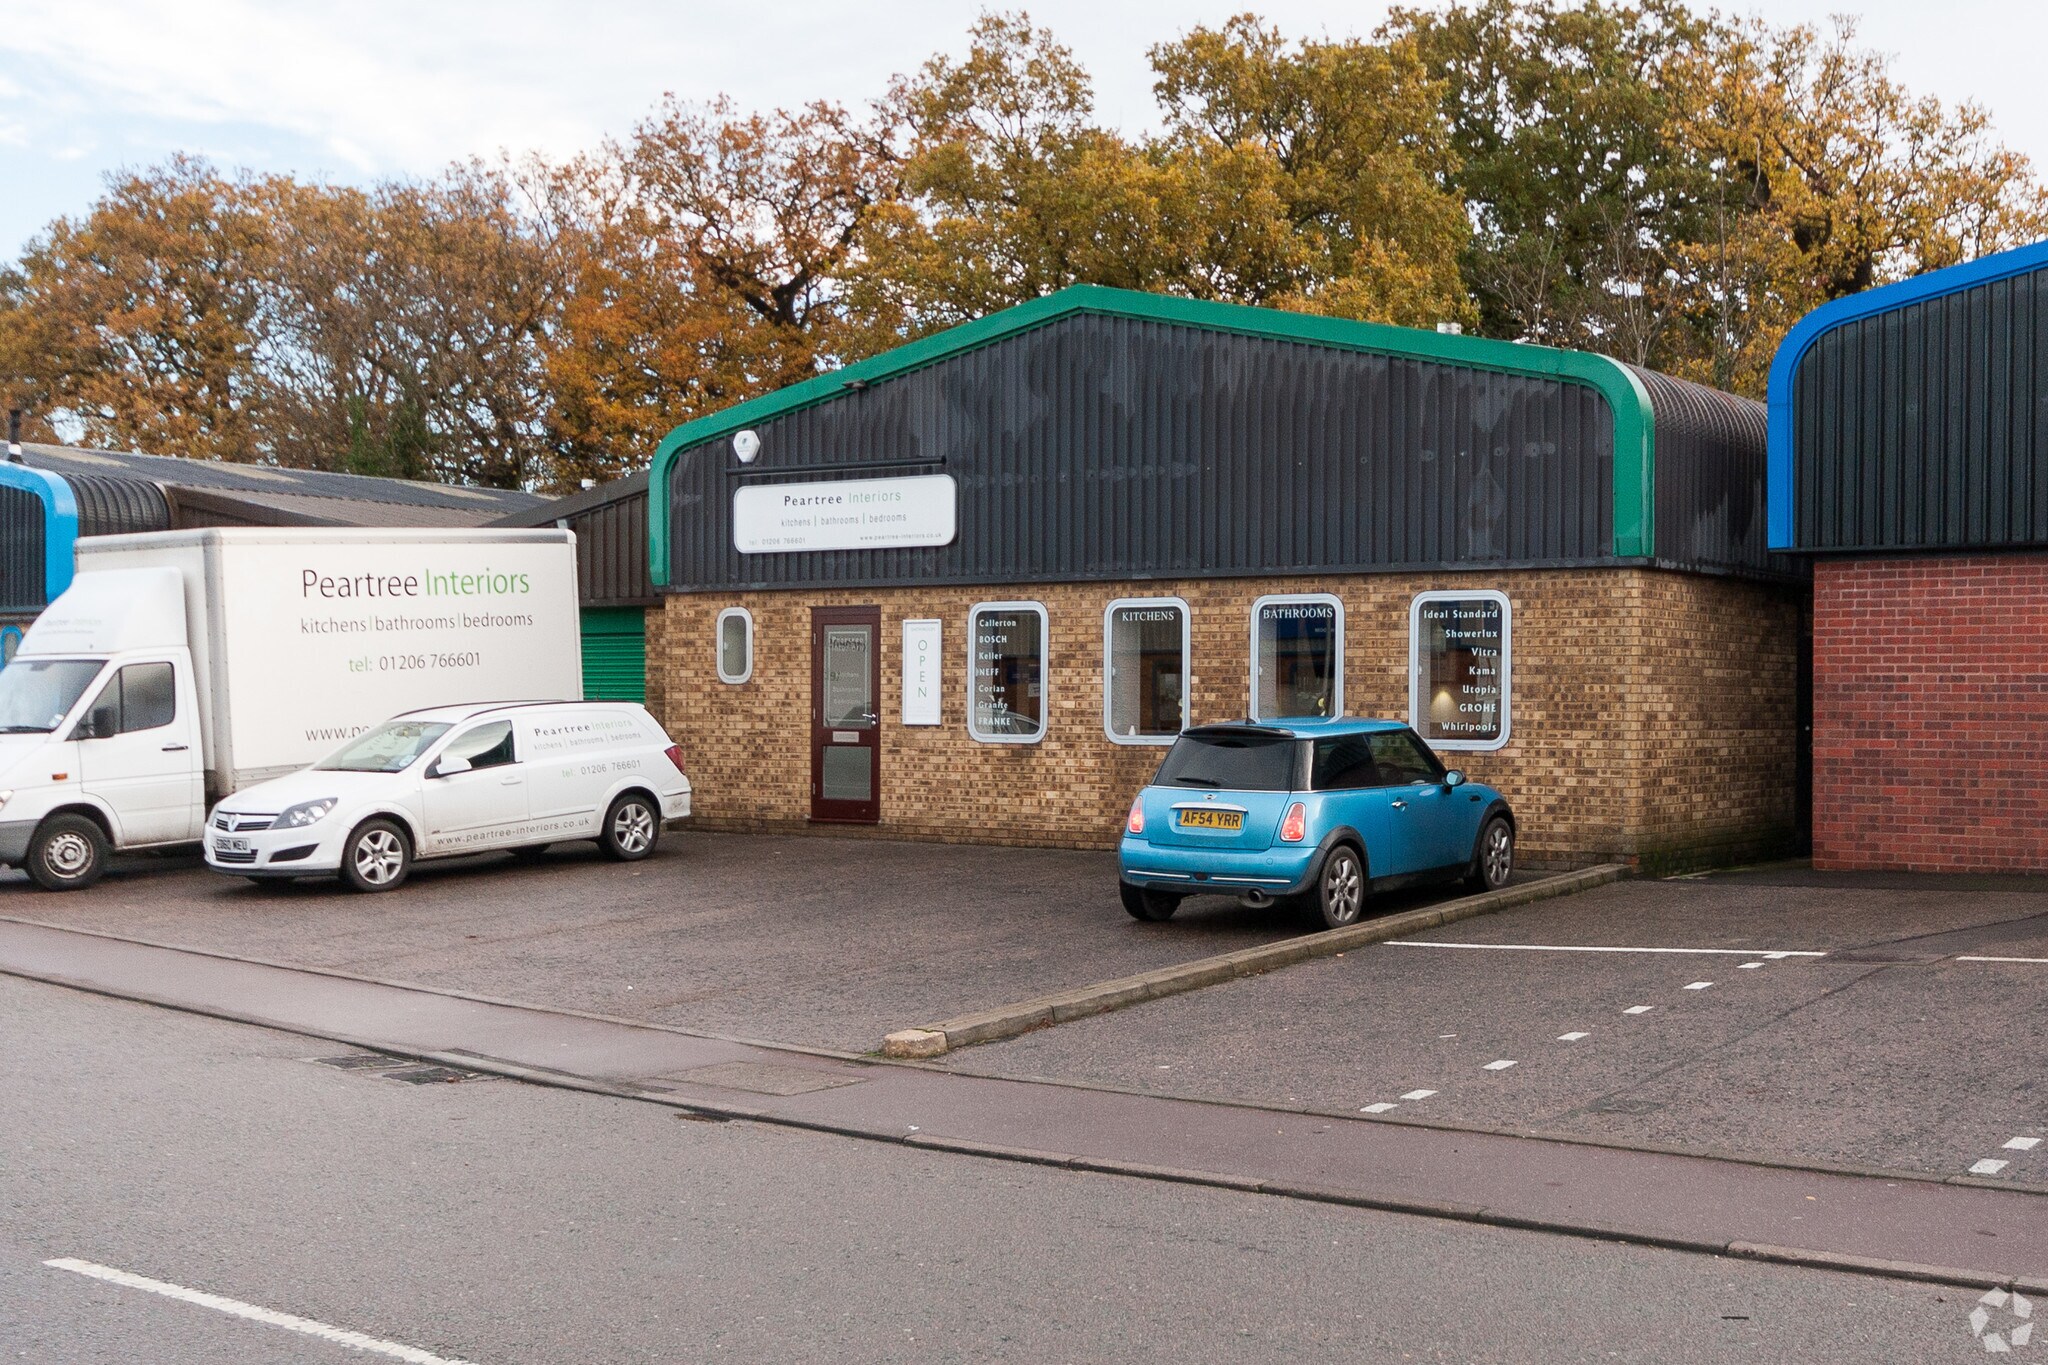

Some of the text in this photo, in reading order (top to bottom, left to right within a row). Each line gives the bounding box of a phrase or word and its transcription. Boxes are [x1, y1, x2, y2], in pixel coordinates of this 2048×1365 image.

[784, 491, 902, 507] Peartree Interiors
[781, 512, 907, 527] kitchens bathrooms bedrooms
[302, 567, 530, 599] Peartree Interiors
[1122, 610, 1175, 621] KITCHENS
[1263, 607, 1333, 619] BATHROOMS
[1423, 609, 1498, 619] Ideal Standard
[301, 611, 533, 634] kitchens bathrooms bedrooms
[979, 619, 1017, 627] Callerton
[979, 635, 1007, 643] BOSCH
[1445, 629, 1498, 638] Showerlux
[978, 652, 1003, 660] Keller
[1471, 647, 1497, 656] Vitra
[349, 652, 481, 672] tel: 01206 766601
[918, 639, 928, 698] OPEN
[979, 668, 999, 676] NEFF
[1469, 665, 1496, 675] Kama
[978, 684, 1005, 692] Corian
[1462, 684, 1496, 695] Utopia
[978, 700, 1008, 709] Granite
[1459, 703, 1496, 713] GROHE
[978, 717, 1011, 725] FRANKE
[1441, 721, 1497, 732] Whirlpools
[534, 719, 633, 737] Peartree Interiors
[569, 736, 604, 747] bathrooms
[610, 731, 642, 743] bedrooms
[580, 764, 607, 776] 01206
[612, 760, 642, 772] 766601
[1183, 811, 1240, 827] AF54 YRR
[436, 817, 591, 845] www.peartree-interiors.co.uk
